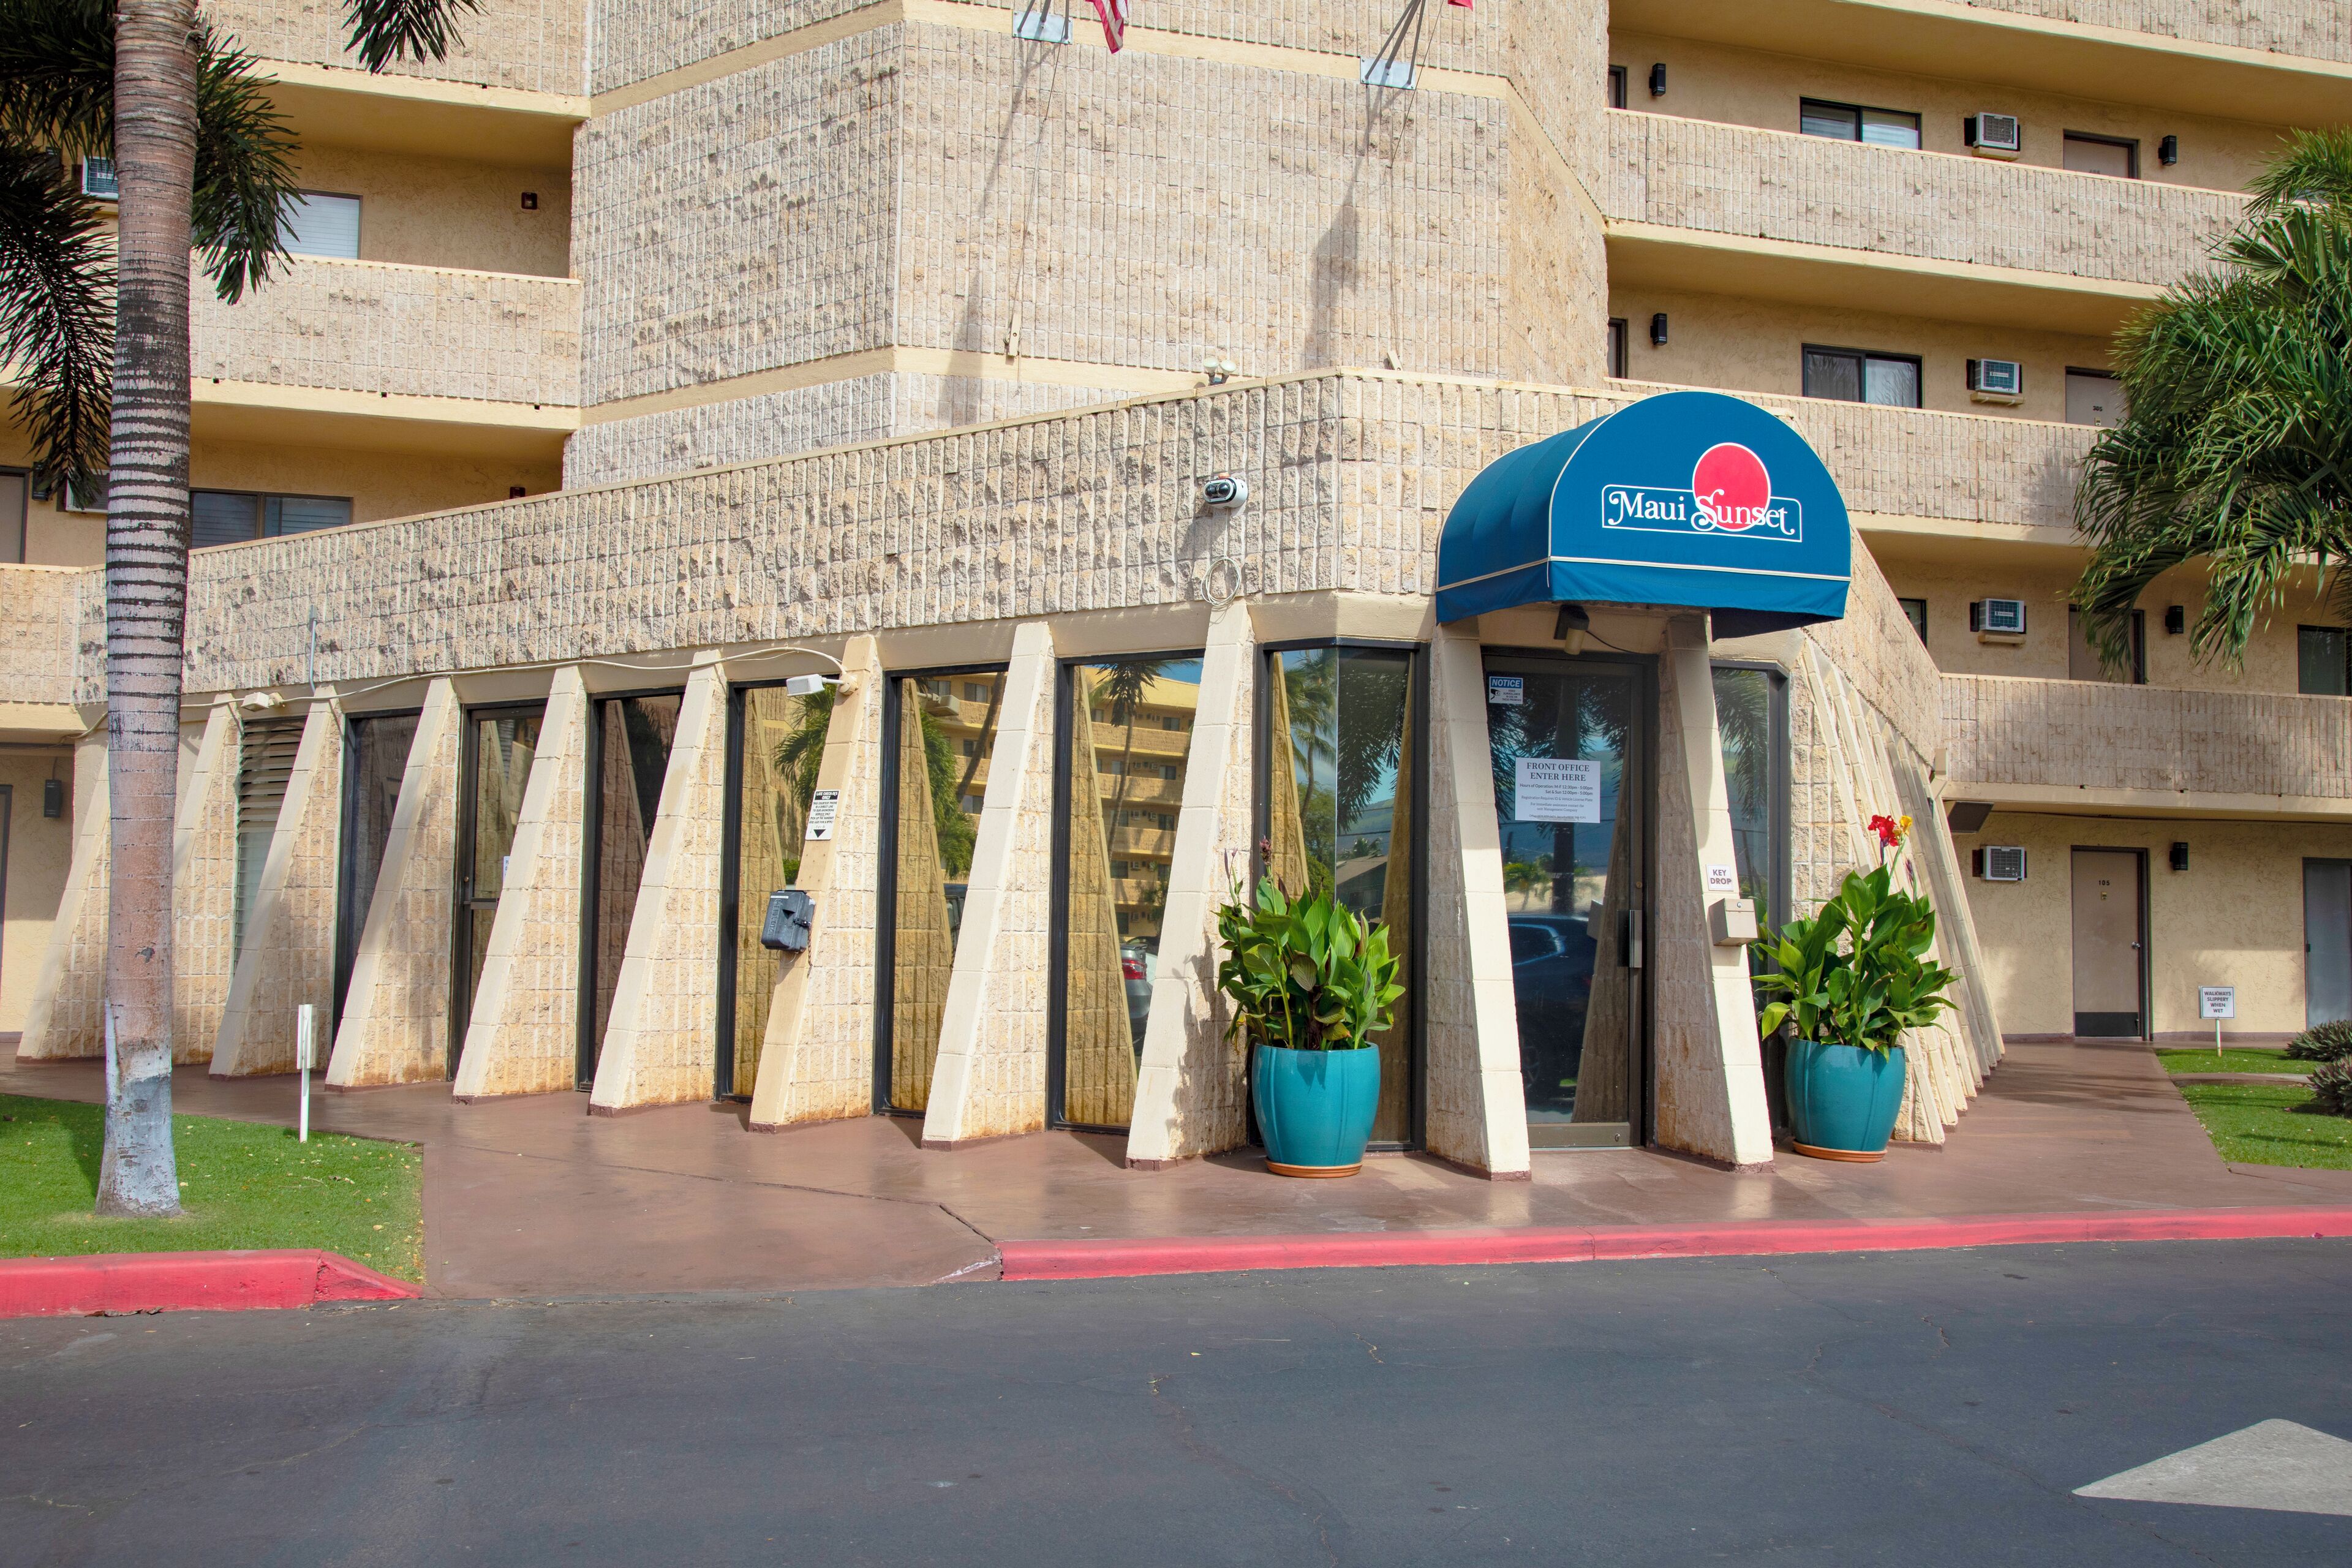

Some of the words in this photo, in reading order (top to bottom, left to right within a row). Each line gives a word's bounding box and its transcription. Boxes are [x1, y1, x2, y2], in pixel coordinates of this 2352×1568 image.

[1608, 491, 1686, 526] Maui
[1691, 489, 1795, 535] Sunset
[1491, 679, 1521, 687] NOTICE
[1558, 763, 1590, 772] OFFICE
[1530, 772, 1559, 780] ENTER
